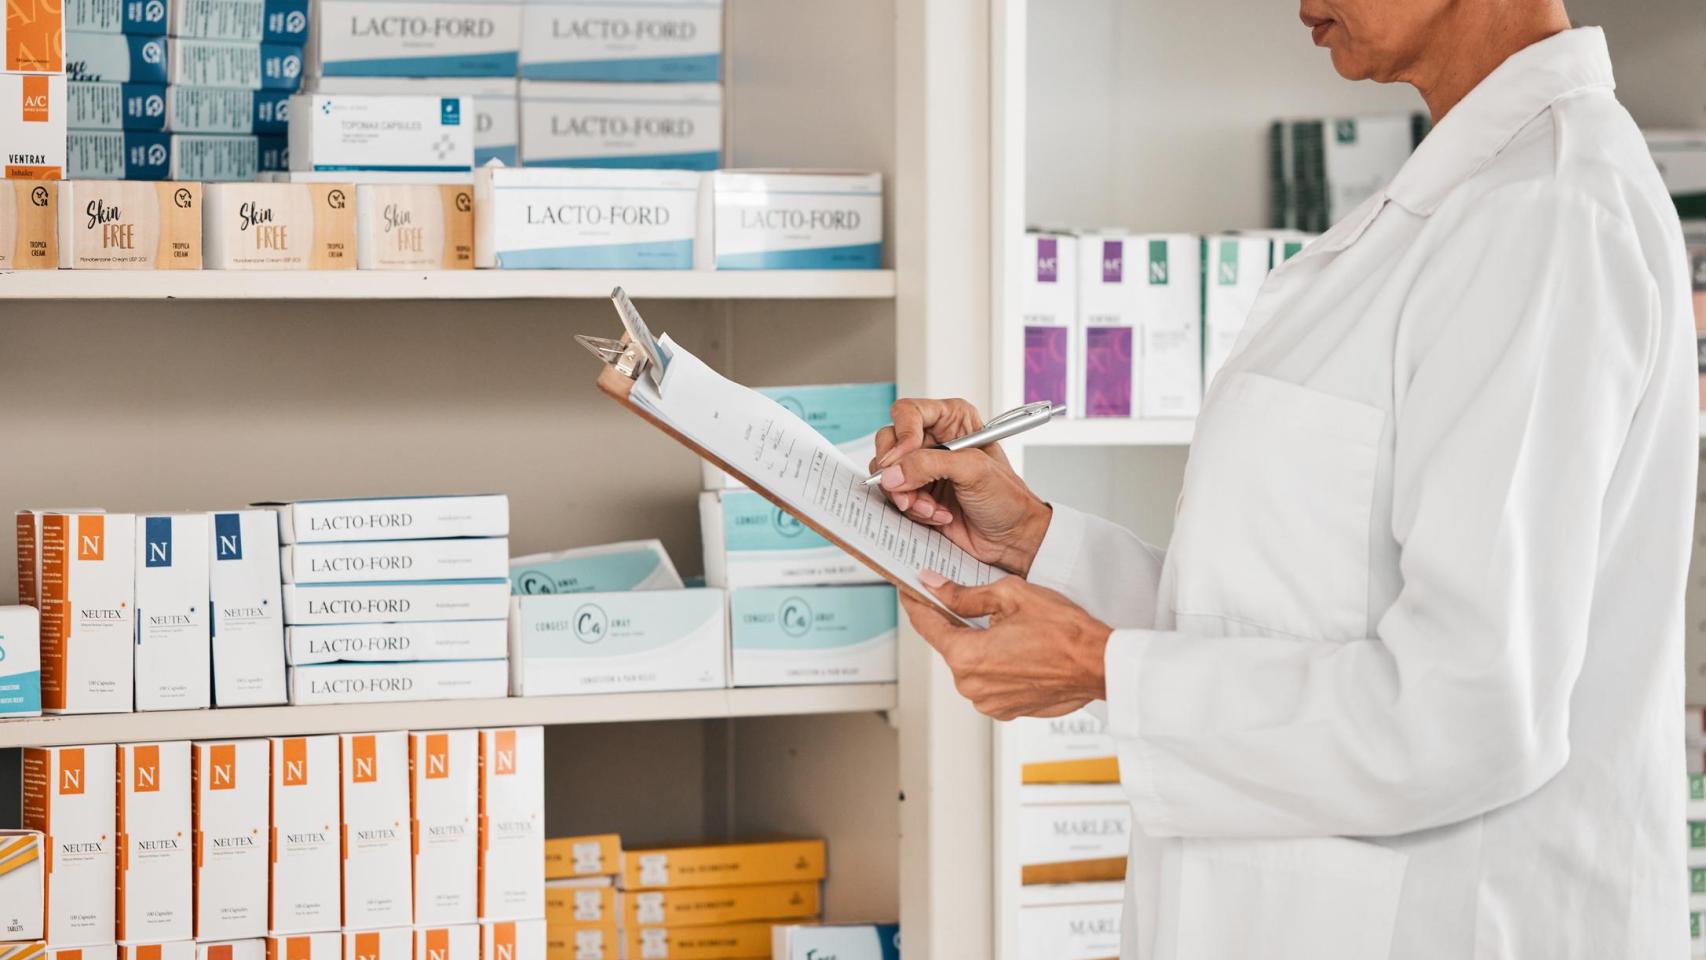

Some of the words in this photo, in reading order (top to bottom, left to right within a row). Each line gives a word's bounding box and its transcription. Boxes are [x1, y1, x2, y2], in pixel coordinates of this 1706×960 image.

[351, 16, 495, 38] LACTO-FORD
[552, 18, 696, 40] LACTO-FORD
[25, 96, 47, 107] A/C
[551, 115, 694, 137] LACTO-FORD
[9, 154, 46, 164] VENTRAX
[86, 199, 122, 230] Skin
[239, 201, 274, 231] Skin
[384, 203, 411, 233] Skin
[526, 205, 670, 226] LACTO-FORD
[741, 209, 860, 230] LACTO-FORD
[103, 223, 135, 250] FREE
[256, 224, 289, 250] FREE
[398, 226, 425, 252] FREE
[174, 250, 189, 258] CREAM
[1151, 261, 1166, 281] N
[311, 513, 413, 531] LACTO-FORD
[82, 535, 99, 555] N
[150, 542, 168, 562] N
[219, 535, 237, 554] N
[311, 555, 413, 572] LACTO-FORD
[81, 609, 121, 619] NEUTEX
[224, 607, 265, 618] NEUTEX
[308, 599, 411, 615] LACTO-FORD
[783, 606, 806, 628] Ca
[150, 615, 191, 625] NEUTEX
[535, 620, 569, 633] CONGEST
[577, 612, 601, 635] Ca
[610, 618, 631, 629] AWAY
[309, 636, 411, 654] LACTO-FORD
[311, 677, 414, 695] LACTO-FORD
[356, 757, 373, 778] N
[429, 754, 446, 774] N
[497, 750, 513, 770] N
[63, 769, 80, 789] N
[138, 766, 155, 787] N
[214, 764, 231, 784] N
[287, 760, 303, 781] N
[357, 829, 396, 840] NEUTEX
[428, 825, 465, 836] NEUTEX
[1053, 818, 1126, 836] MARLEX
[62, 842, 102, 854] NEUTEX
[138, 840, 178, 850] NEUTEX
[213, 837, 253, 848] NEUTEX
[287, 833, 326, 844] NEUTEX
[497, 944, 513, 960] N
